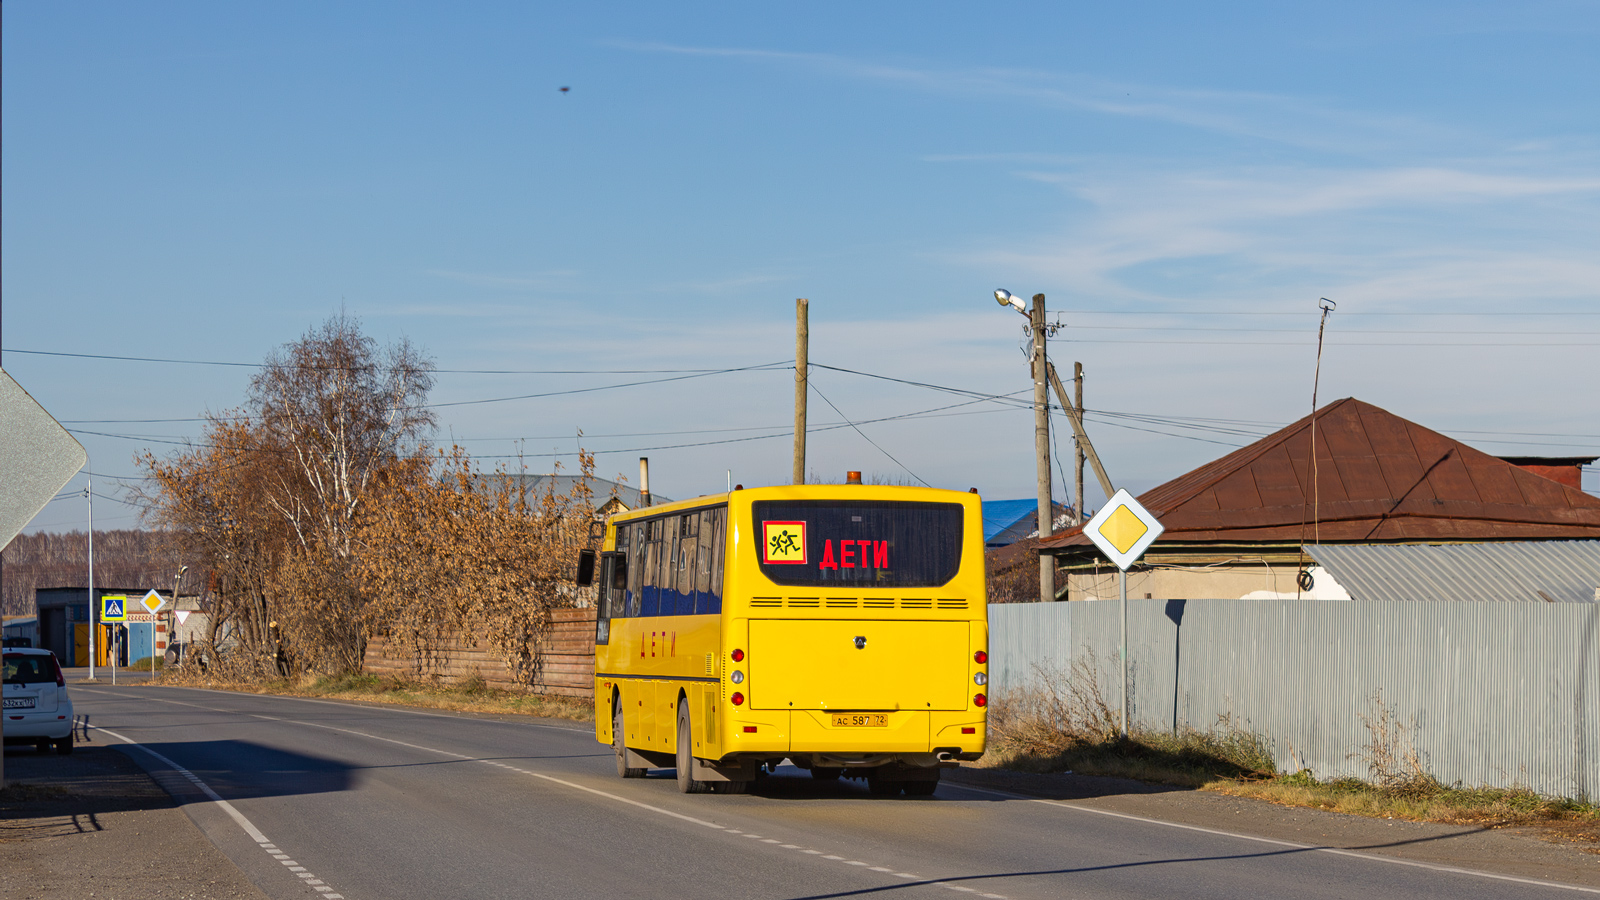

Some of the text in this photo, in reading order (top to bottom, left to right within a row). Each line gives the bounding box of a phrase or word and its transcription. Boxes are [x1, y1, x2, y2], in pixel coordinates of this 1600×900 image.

[819, 539, 888, 570] ДЕТИ
[640, 631, 676, 660] ДЕТИ
[852, 715, 870, 726] 587
[875, 715, 885, 724] 72
